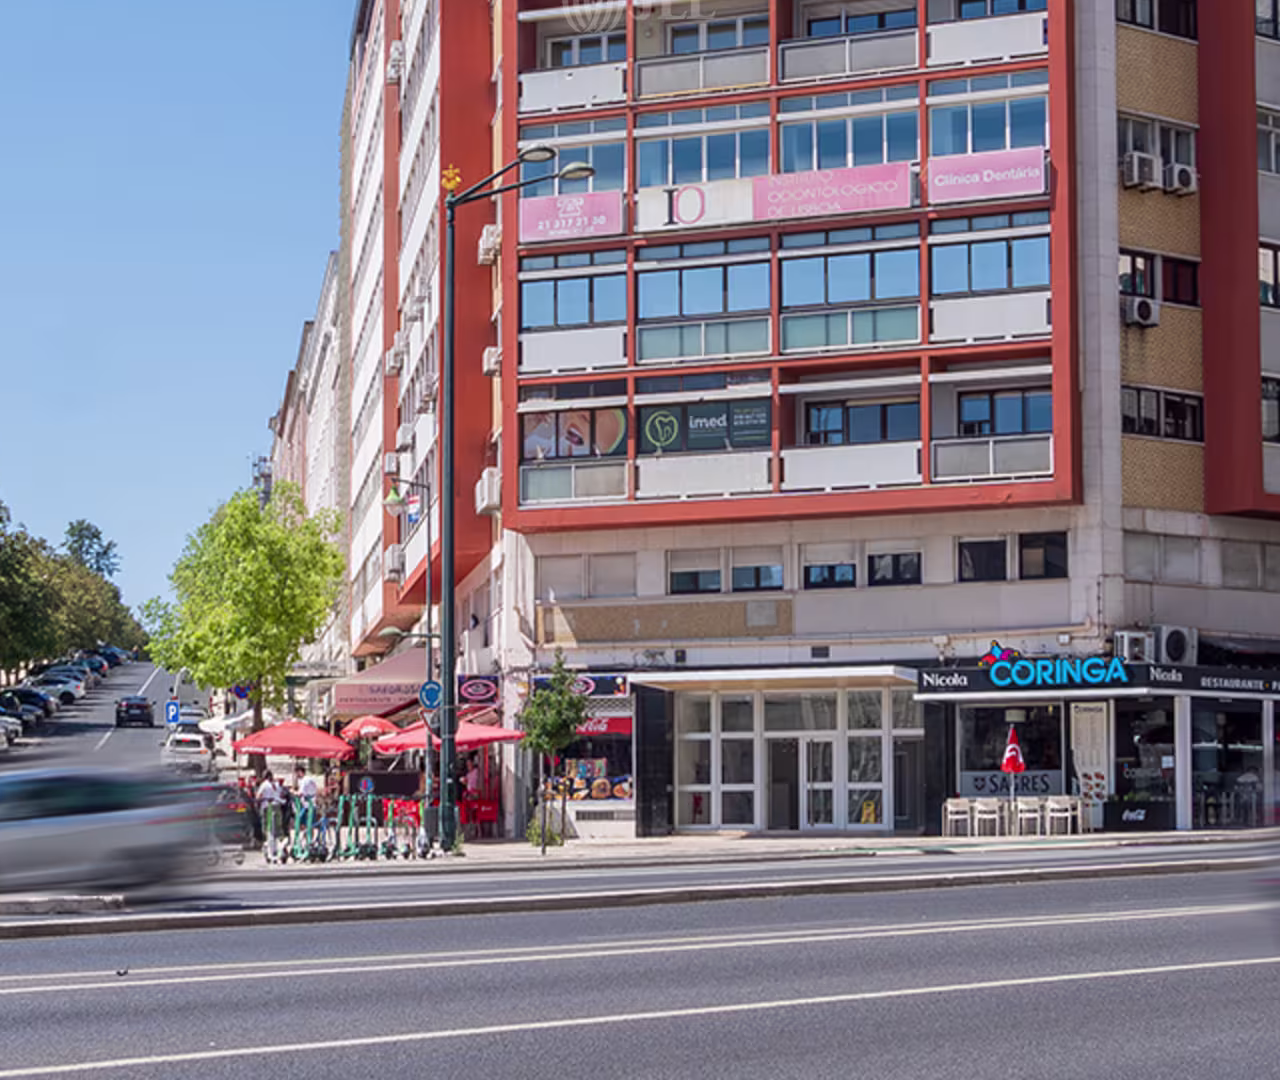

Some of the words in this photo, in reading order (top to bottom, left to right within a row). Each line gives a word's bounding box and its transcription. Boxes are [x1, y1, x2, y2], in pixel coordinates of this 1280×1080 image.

[923, 672, 968, 687] Nicola
[989, 658, 1128, 686] CORINGA
[1201, 677, 1264, 690] RESTAURANTE
[168, 705, 179, 721] P
